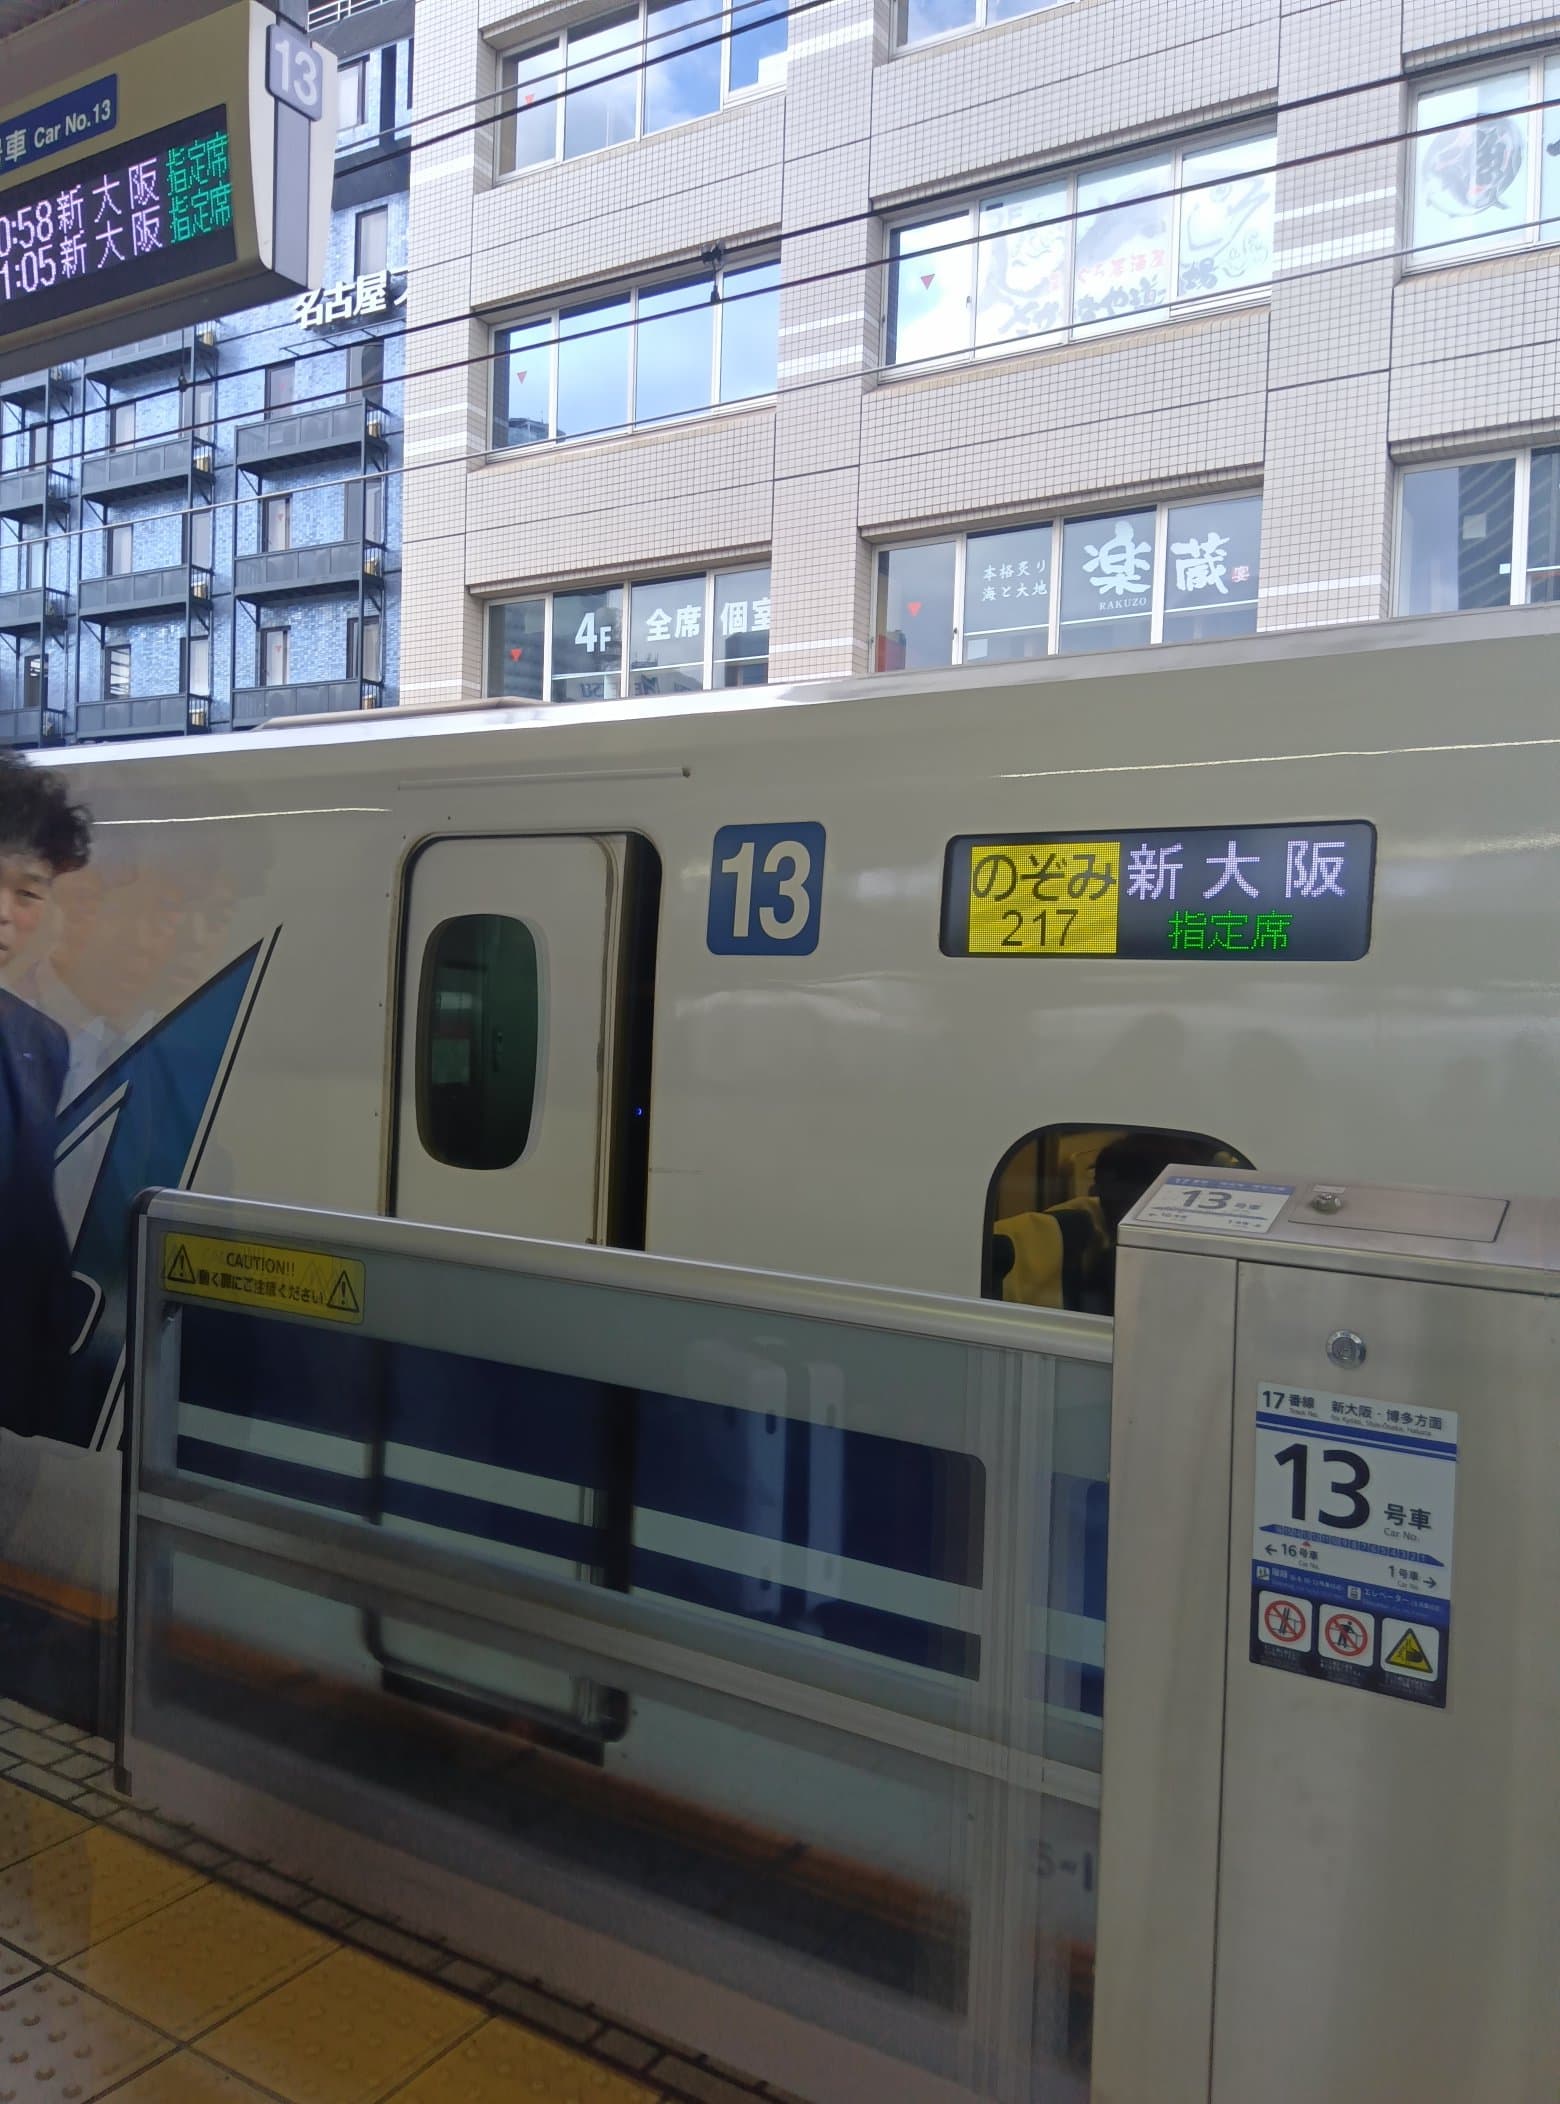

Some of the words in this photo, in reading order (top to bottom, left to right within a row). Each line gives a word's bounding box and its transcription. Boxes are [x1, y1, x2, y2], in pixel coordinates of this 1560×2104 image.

[275, 39, 318, 107] 13
[0, 128, 27, 162] 車
[34, 124, 61, 149] Car
[166, 130, 230, 197] 指定席
[169, 180, 233, 244] 指定席
[292, 269, 408, 330] 名古屋
[982, 559, 1047, 582] 本格炙り
[1081, 520, 1231, 596] 楽蔵
[981, 582, 1048, 603] 海と大地
[1099, 596, 1147, 611] RAKUZO
[574, 612, 613, 653] 4F
[720, 840, 812, 940] 13
[971, 852, 1117, 902] のぞみ
[1126, 839, 1346, 901] 新大阪
[1000, 909, 1079, 948] 217
[1168, 910, 1294, 952] 指定席
[1182, 1189, 1233, 1210] 13
[226, 1251, 296, 1277] CAUTION!!
[1274, 1442, 1371, 1530] 13
[1384, 1502, 1432, 1530] 号車
[1384, 1527, 1400, 1538] Car
[1403, 1530, 1420, 1542] No.
